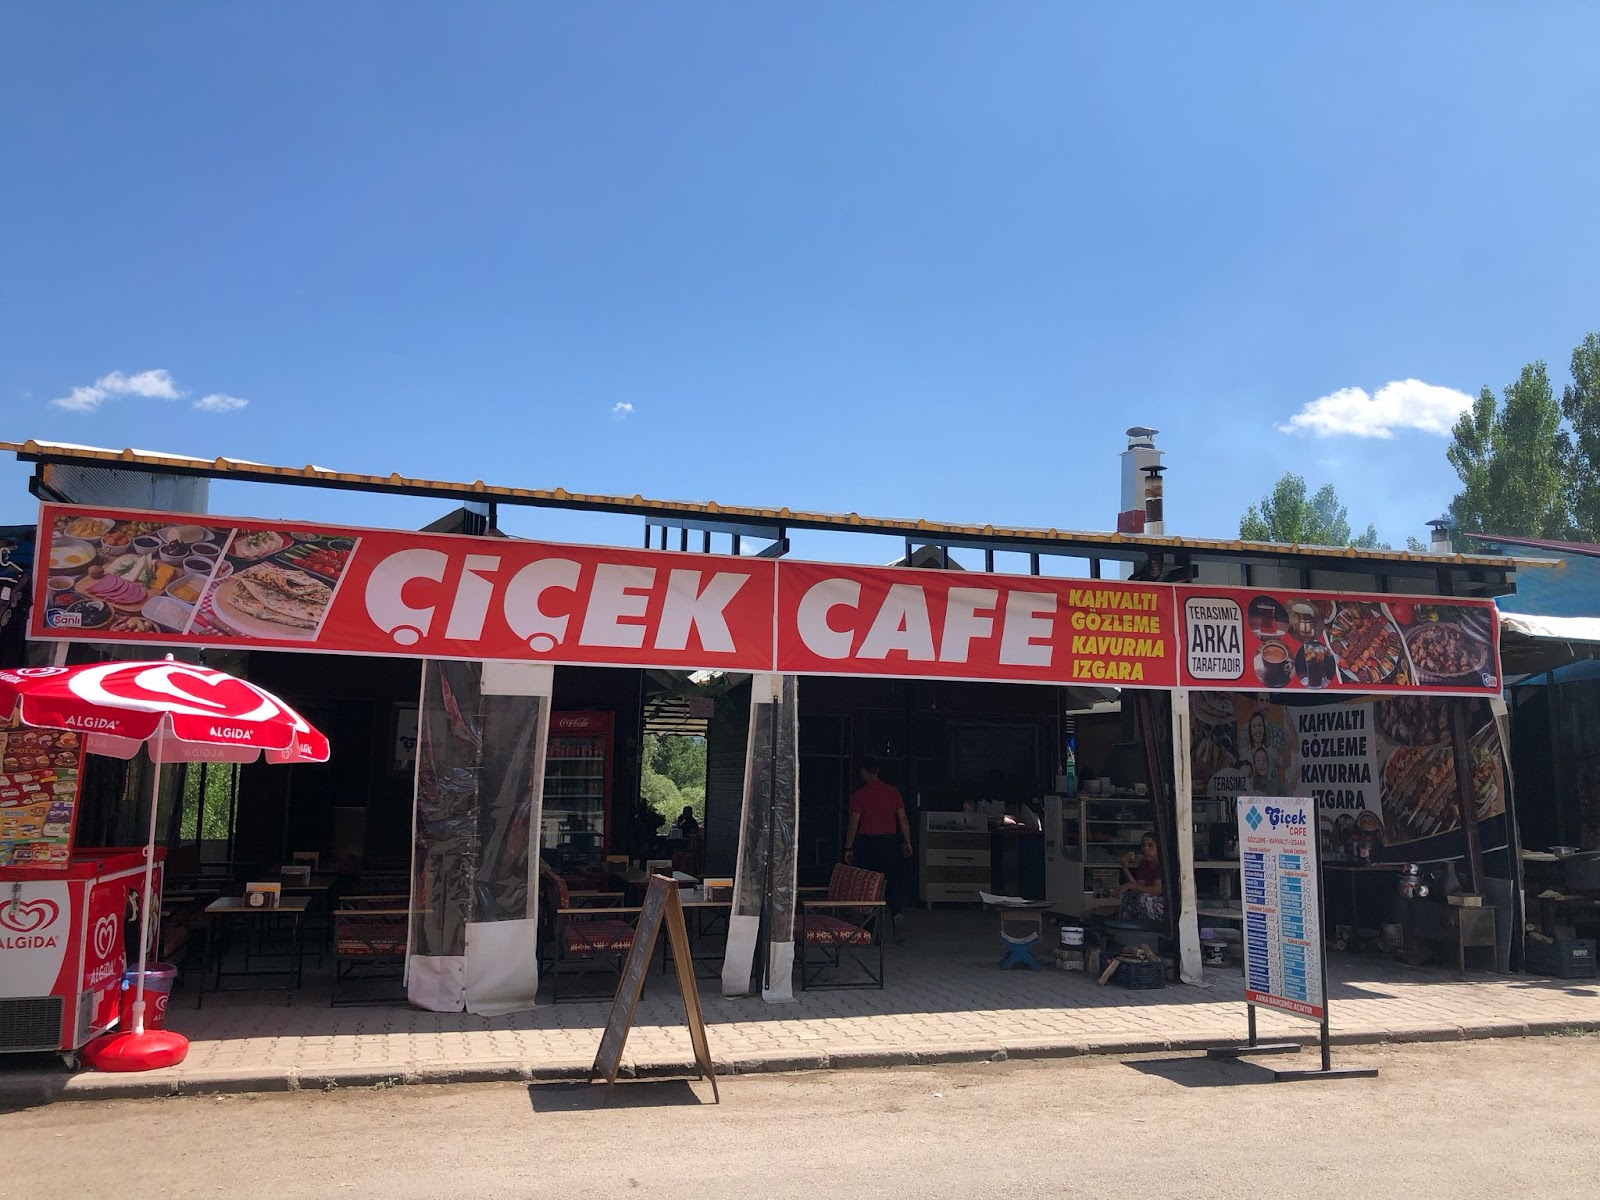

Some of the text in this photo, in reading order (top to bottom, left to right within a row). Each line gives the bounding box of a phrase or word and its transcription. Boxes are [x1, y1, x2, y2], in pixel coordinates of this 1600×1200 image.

[1069, 589, 1157, 610] KAHVALTI
[796, 578, 1058, 666] CAFE
[1071, 609, 1160, 633] GÖZLEME
[1188, 606, 1239, 620] TERASIMIZ
[1071, 635, 1164, 657] KAVURMA
[1191, 624, 1240, 653] ARKA
[1072, 660, 1143, 680] IZGARA
[1192, 657, 1241, 672] TARAFTADIR
[1299, 710, 1364, 732] KAHVALTI
[1301, 733, 1367, 758] GÖZLEME
[1213, 776, 1247, 791] TERASIMIZ
[1301, 763, 1371, 783] KAVURMA
[1265, 806, 1306, 830] Çiçek
[1289, 827, 1307, 836] CAFE
